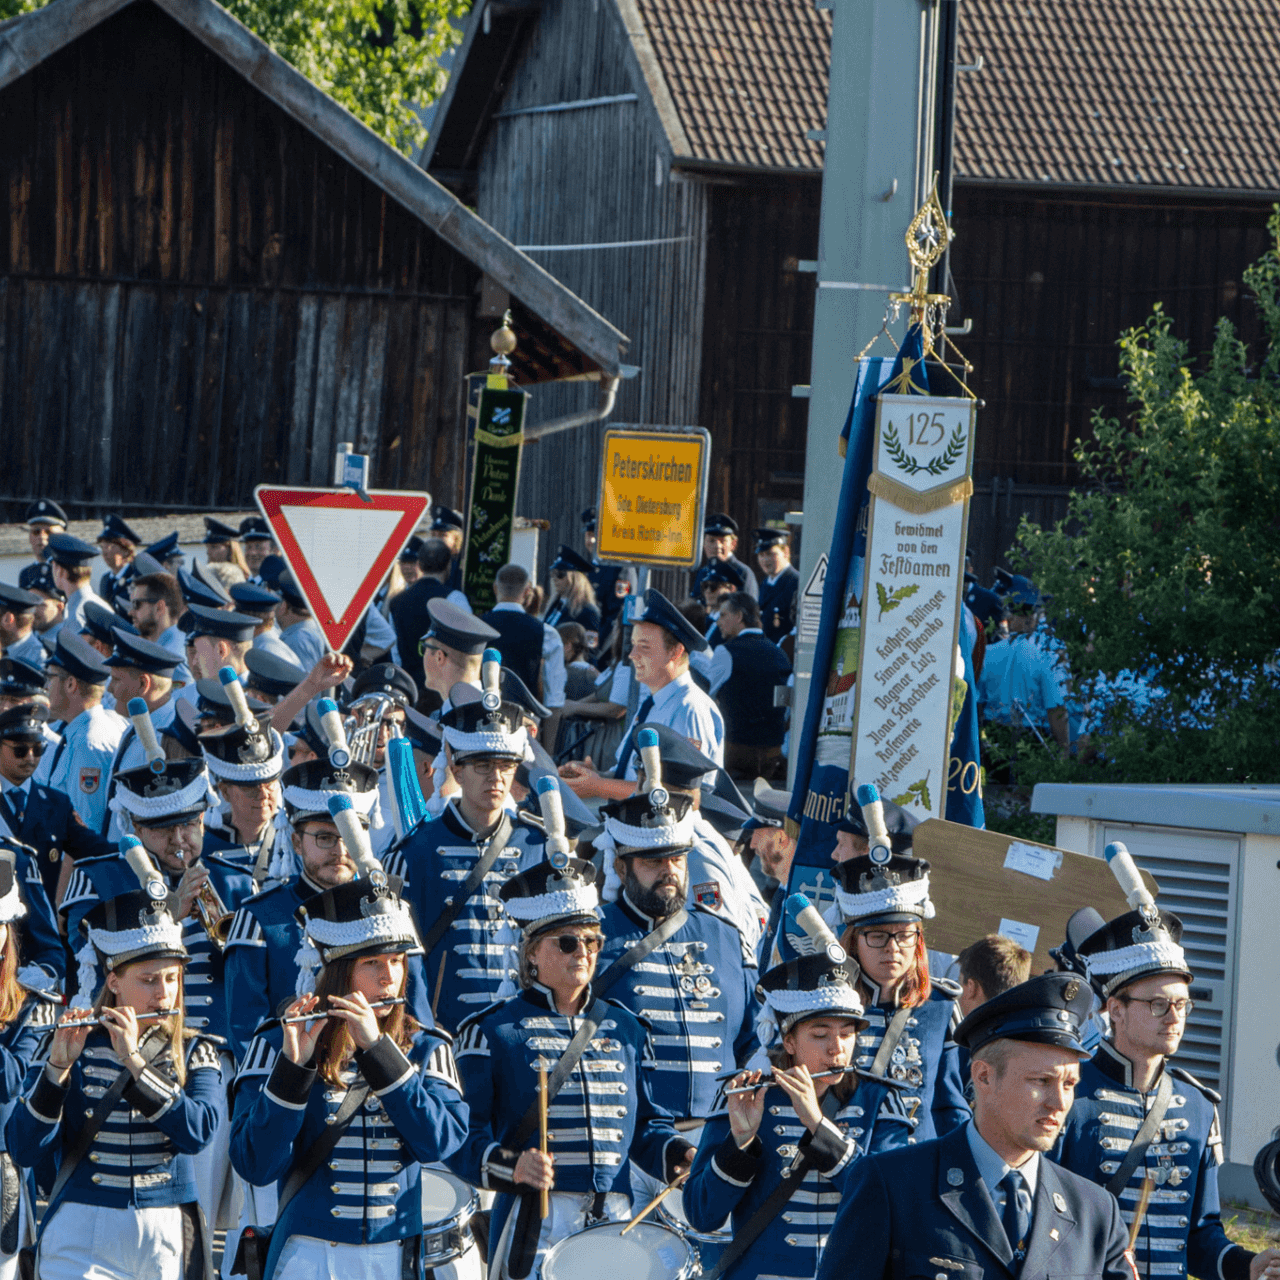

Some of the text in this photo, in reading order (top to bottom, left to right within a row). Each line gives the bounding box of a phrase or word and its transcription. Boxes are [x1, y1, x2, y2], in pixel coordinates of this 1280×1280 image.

[906, 412, 946, 447] 125
[612, 452, 693, 484] Peterskirchen
[635, 494, 682, 521] Dietersburg
[612, 524, 636, 540] Kreis
[897, 540, 938, 554] von den
[879, 553, 951, 578] Festdamen
[876, 589, 947, 661] Kathrin Billinger
[874, 652, 910, 687] Simone
[874, 651, 937, 711] Dagmar Lutz
[891, 673, 941, 720] Schachtner
[875, 718, 922, 764] Rosemarie
[948, 757, 983, 799] 20
